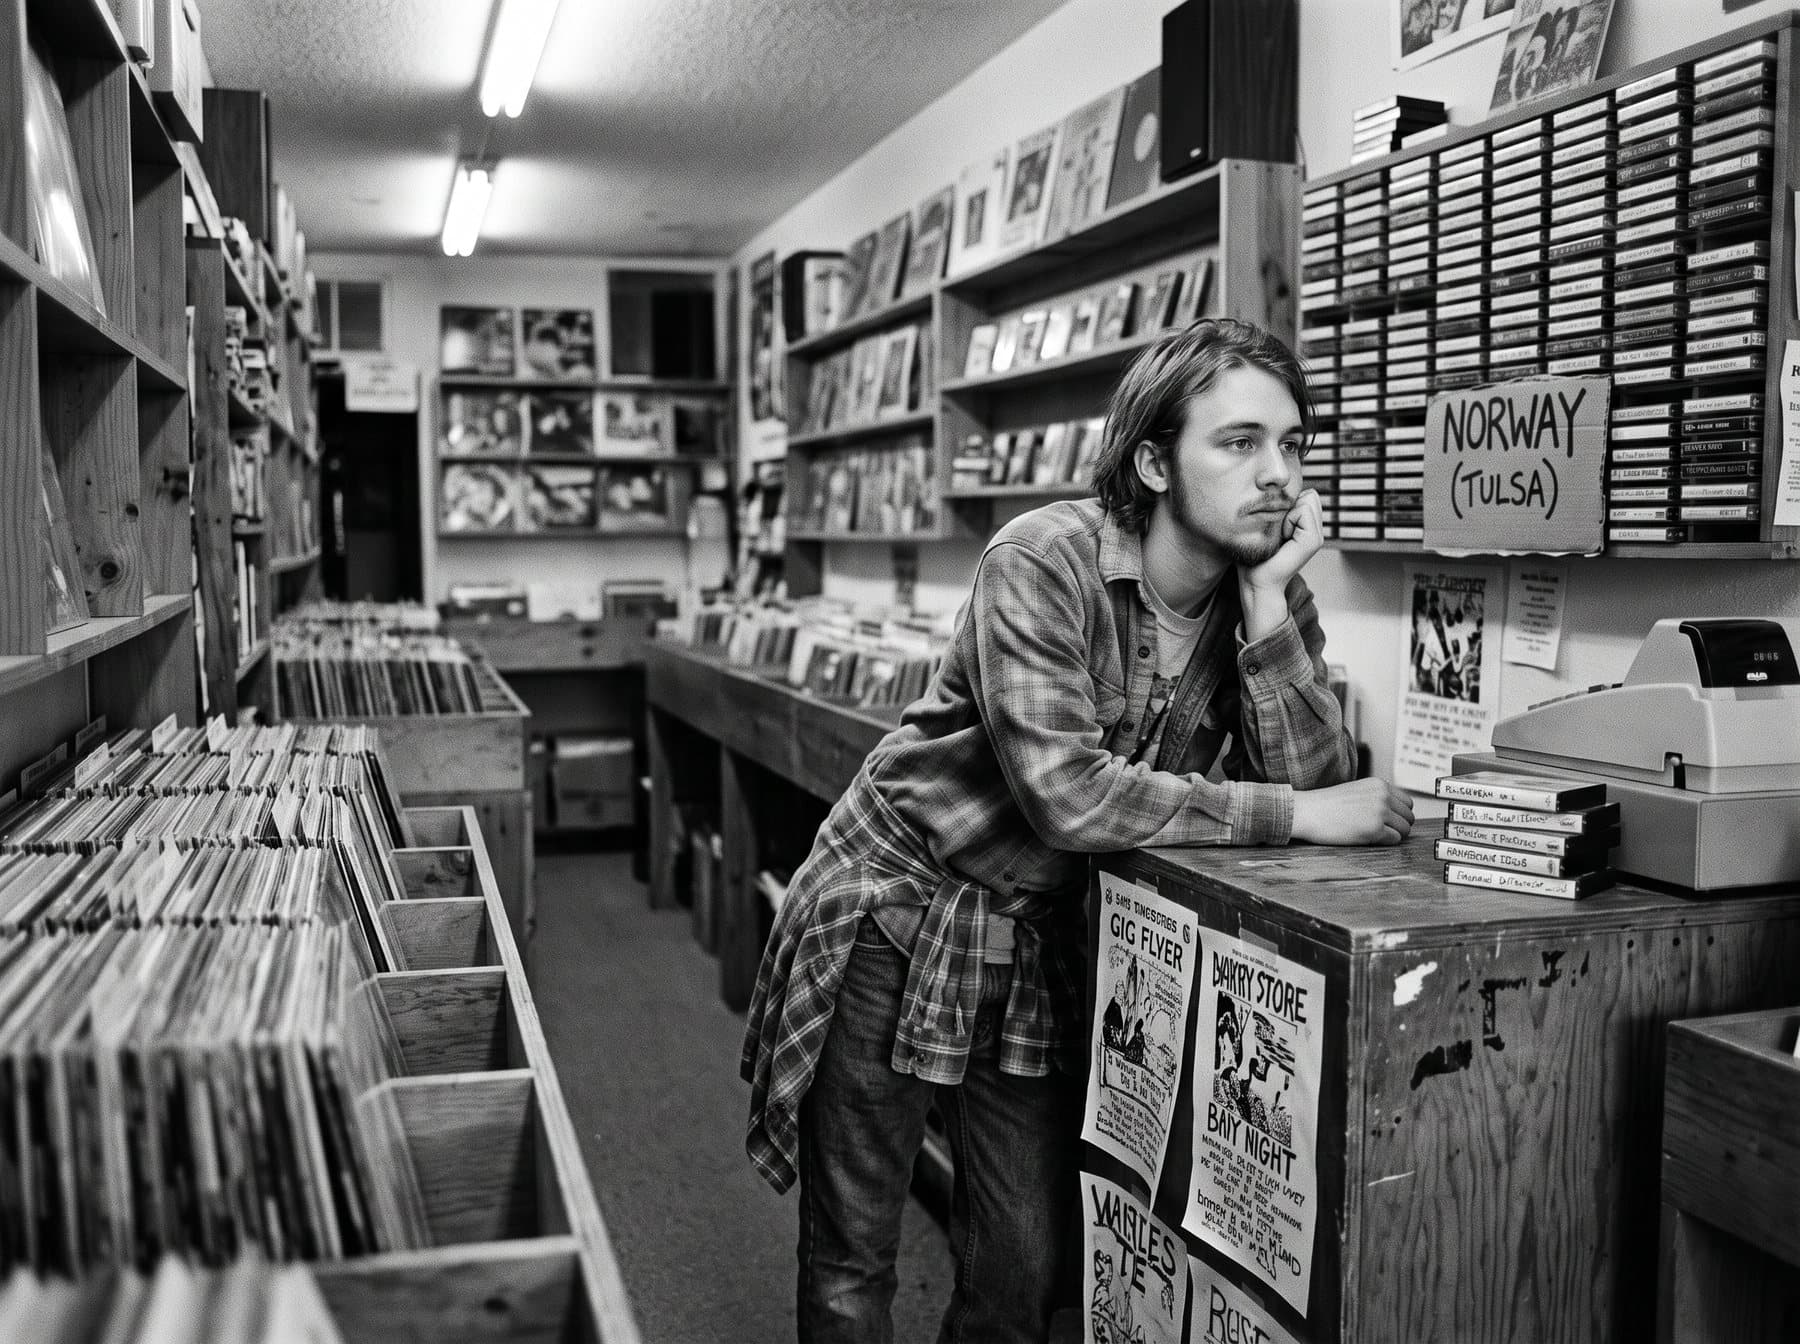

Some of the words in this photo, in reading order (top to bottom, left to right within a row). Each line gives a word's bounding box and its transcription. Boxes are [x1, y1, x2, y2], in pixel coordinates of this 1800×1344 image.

[1443, 388, 1587, 458] NORWAY
[1451, 457, 1558, 520] (TULSA)
[1110, 913, 1136, 946] GIG
[1141, 926, 1182, 973] FLYER
[1257, 971, 1308, 1024] STORE
[1245, 1125, 1297, 1181] NIGHT
